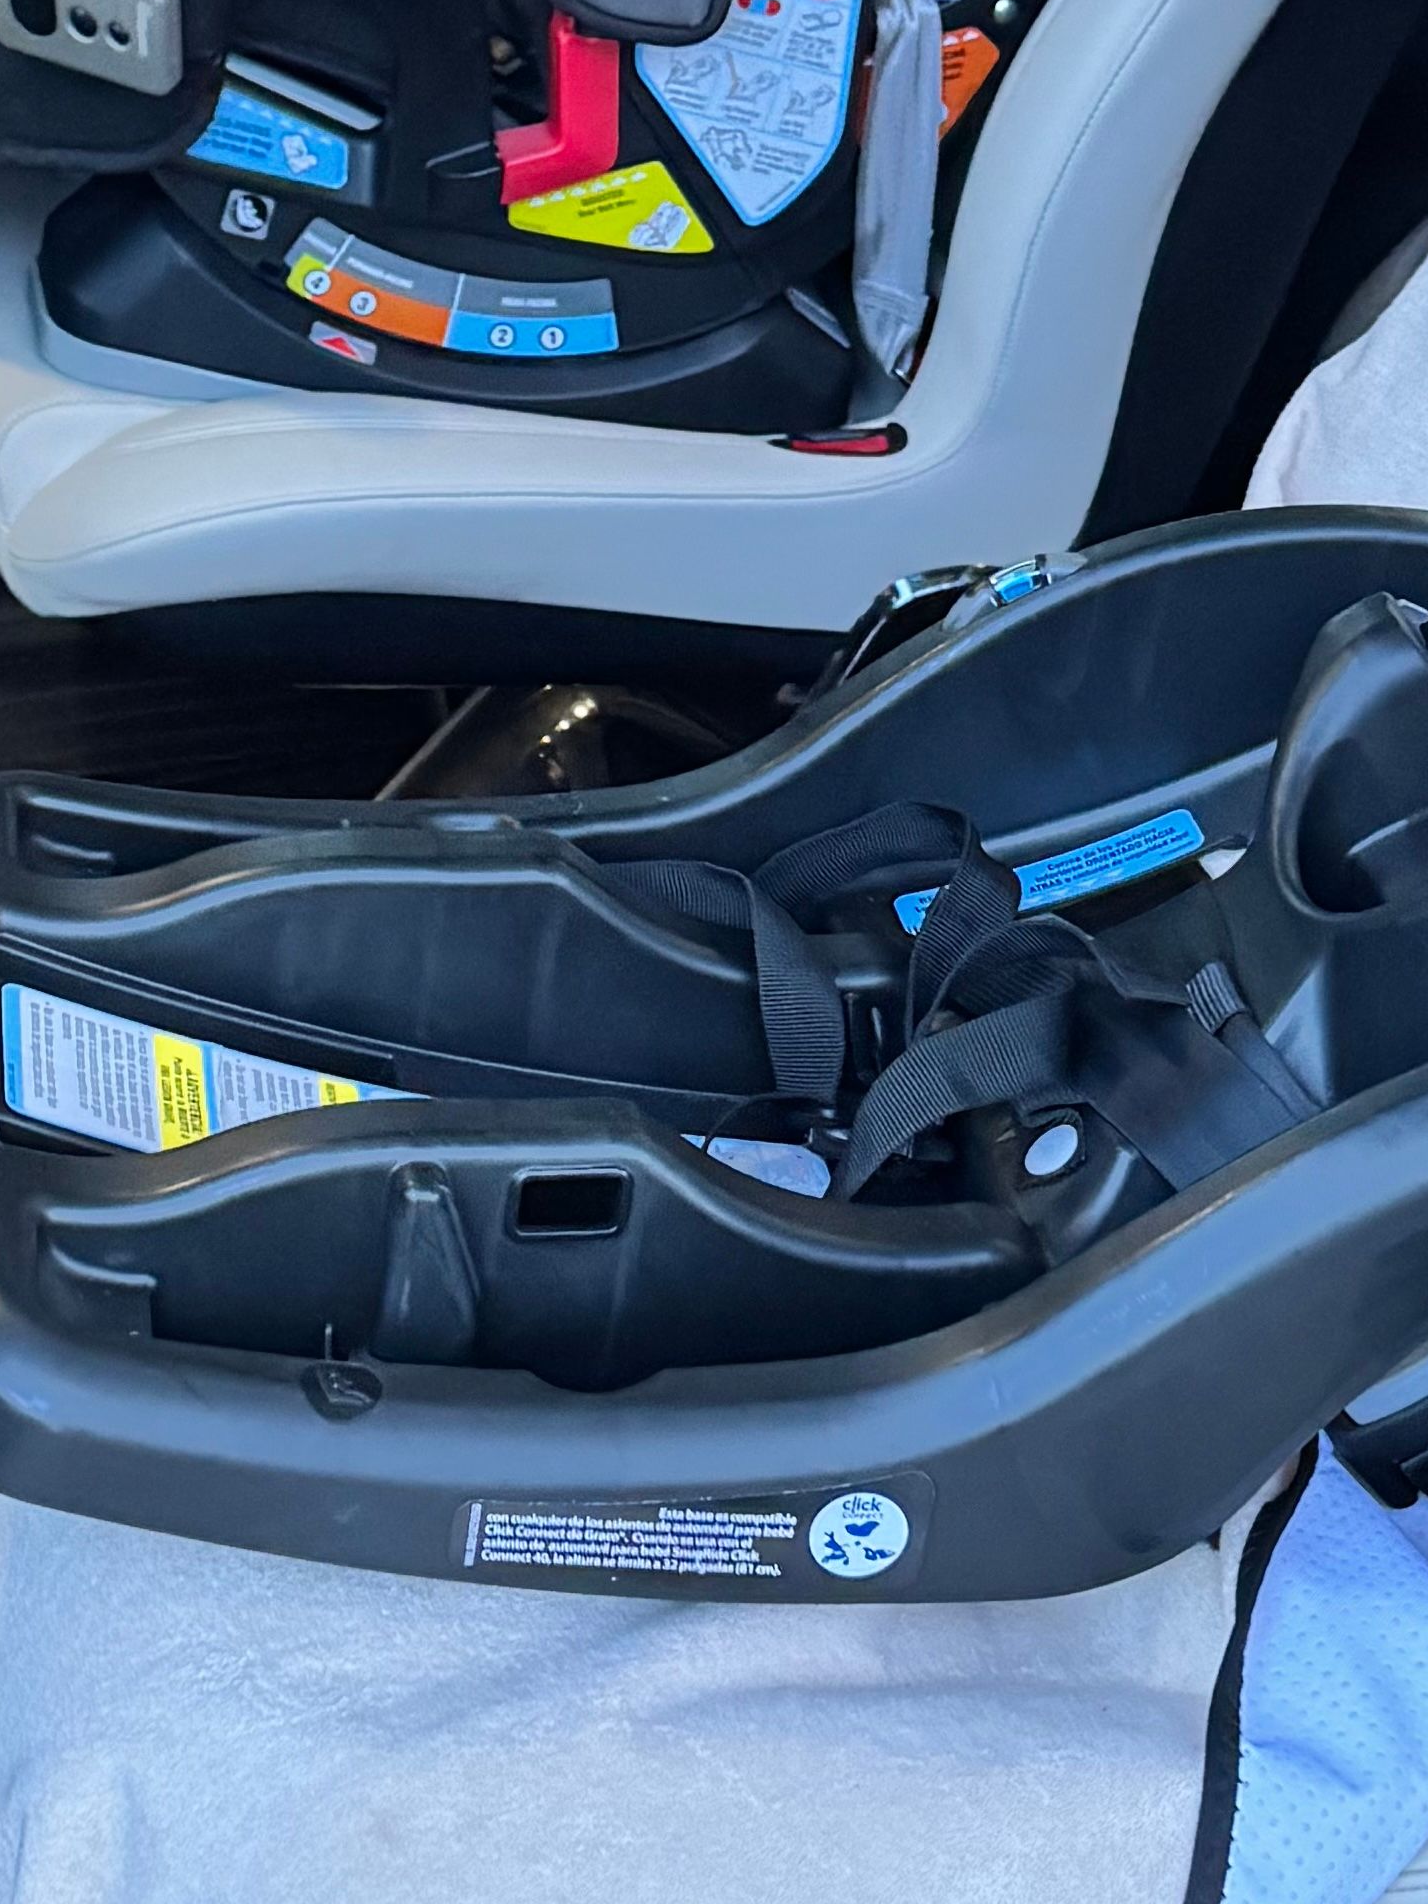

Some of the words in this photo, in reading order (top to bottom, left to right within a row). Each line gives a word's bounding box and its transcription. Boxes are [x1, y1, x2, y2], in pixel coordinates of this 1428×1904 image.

[497, 328, 509, 344] 2
[658, 1507, 685, 1520] Esta
[686, 1508, 714, 1522] base
[730, 1512, 798, 1526] compatible
[842, 1495, 883, 1514] click
[484, 1524, 514, 1537] Click
[515, 1525, 566, 1540] Connect
[566, 1528, 583, 1540] de
[631, 1532, 679, 1545] Cuando
[695, 1537, 716, 1547] usa
[718, 1537, 739, 1548] con
[740, 1537, 753, 1549] el
[486, 1513, 510, 1524] con
[511, 1513, 568, 1527] cualquier
[568, 1515, 584, 1528] de
[586, 1516, 603, 1529] los
[605, 1518, 655, 1532] asientos
[656, 1520, 671, 1532] de
[734, 1525, 762, 1538] para
[481, 1549, 532, 1563] Connect
[553, 1552, 565, 1565] la
[565, 1553, 602, 1567] altura
[602, 1557, 617, 1568] se
[617, 1555, 652, 1570] limita
[662, 1558, 678, 1571] 32
[678, 1561, 734, 1575] pulgadas
[482, 1537, 528, 1550] asiento
[529, 1539, 546, 1551] de
[610, 1544, 639, 1557] para
[672, 1546, 729, 1561] SnugRide
[730, 1549, 760, 1562] Click
